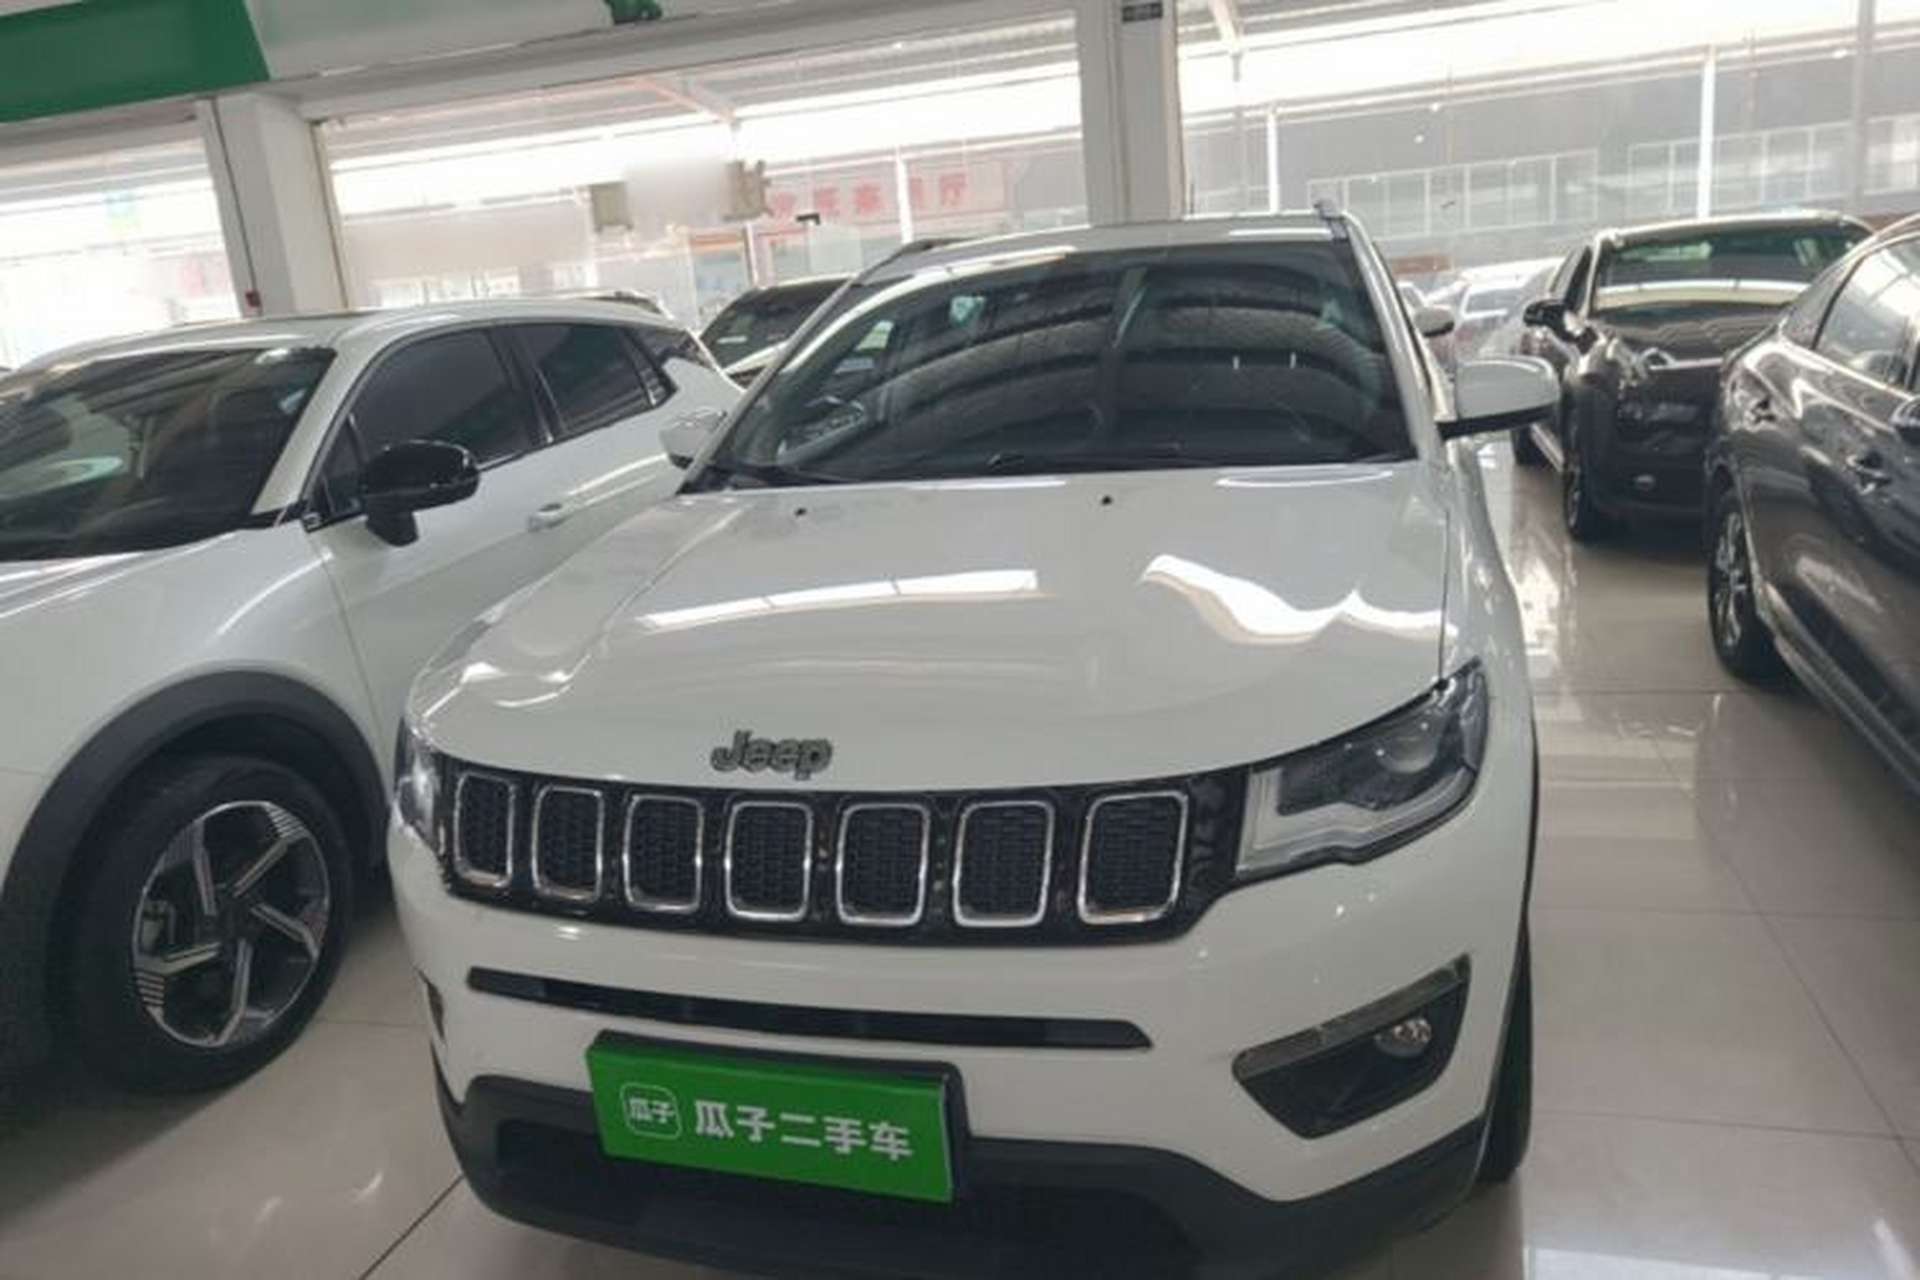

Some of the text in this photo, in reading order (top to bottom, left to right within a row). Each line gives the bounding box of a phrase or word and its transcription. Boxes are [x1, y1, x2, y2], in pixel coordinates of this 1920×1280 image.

[710, 730, 833, 781] Jeep
[628, 1097, 675, 1123] 瓜子
[695, 1099, 913, 1161] 瓜子二手车
